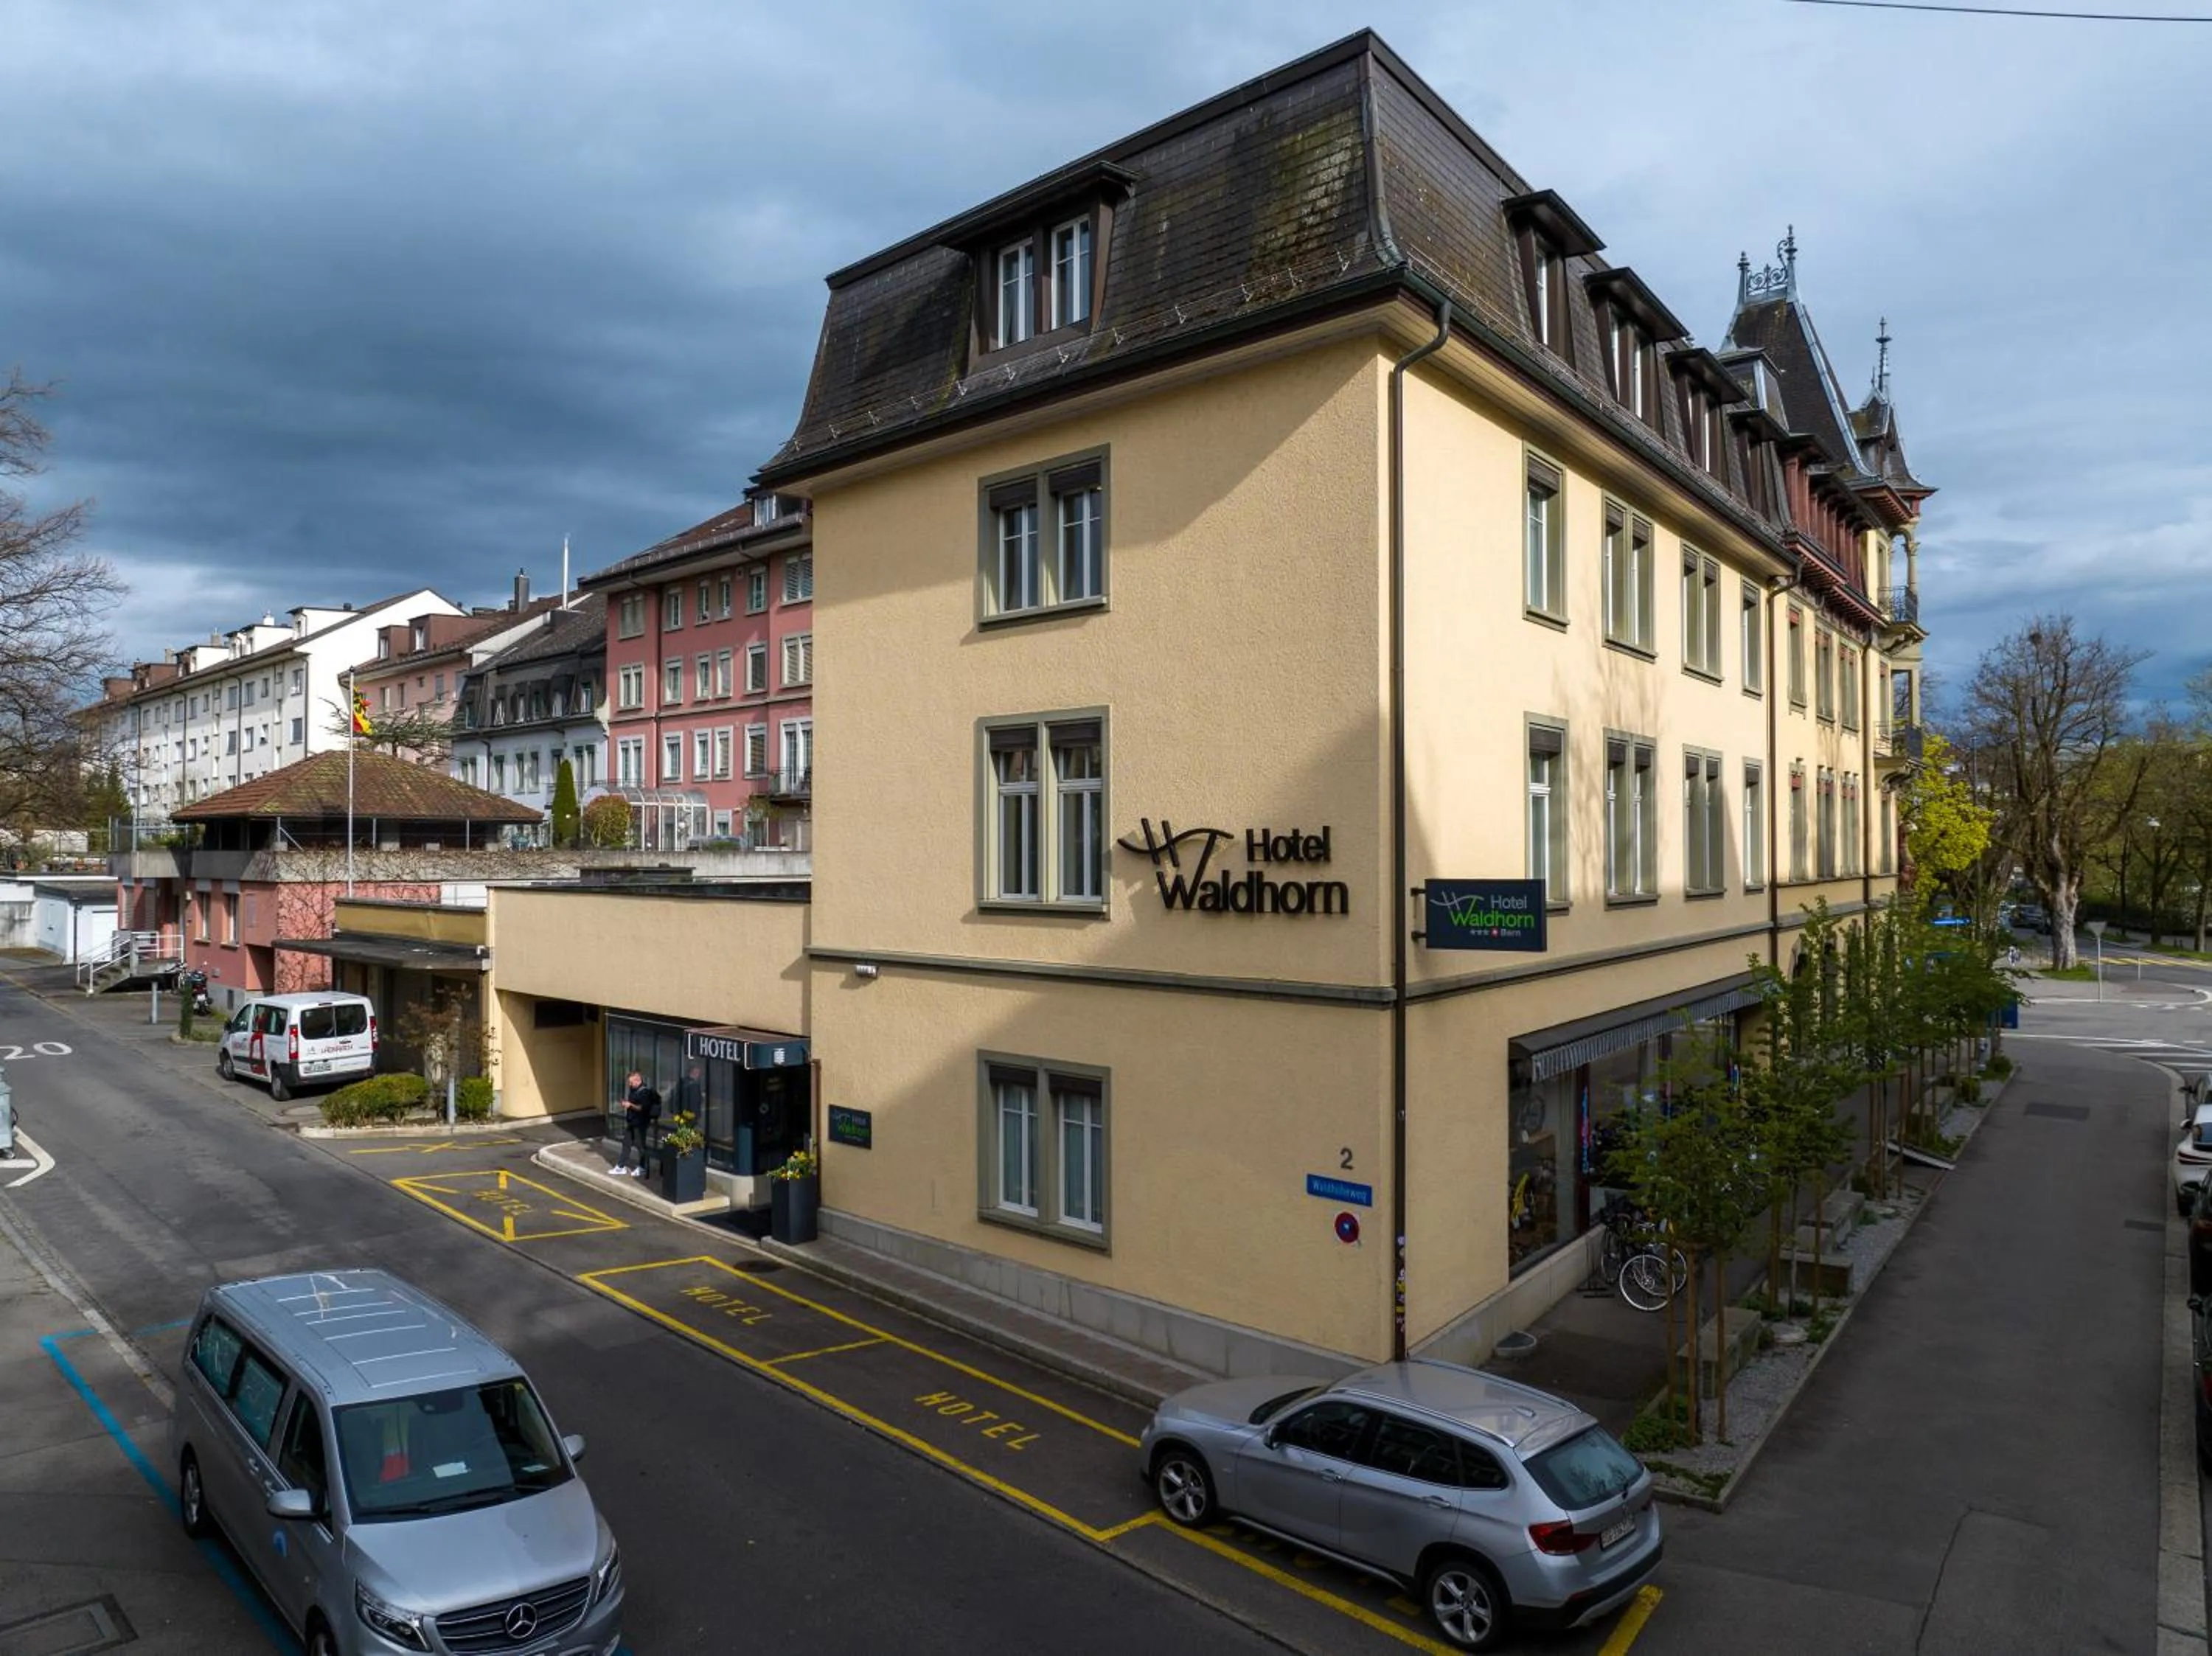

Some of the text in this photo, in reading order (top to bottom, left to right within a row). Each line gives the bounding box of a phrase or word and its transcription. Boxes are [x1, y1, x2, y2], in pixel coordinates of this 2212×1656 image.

[1246, 825, 1331, 863] Hotel
[1156, 870, 1349, 914] Waldhorn
[1490, 894, 1527, 909] Hotel
[1450, 910, 1534, 928] Waldhorn
[1500, 928, 1521, 937] Bern
[0, 1042, 72, 1060] 20
[699, 1037, 741, 1062] HOTEL
[1340, 1147, 1354, 1170] 2
[680, 1286, 772, 1326] HOTEL
[915, 1391, 1041, 1450] HOTEL
